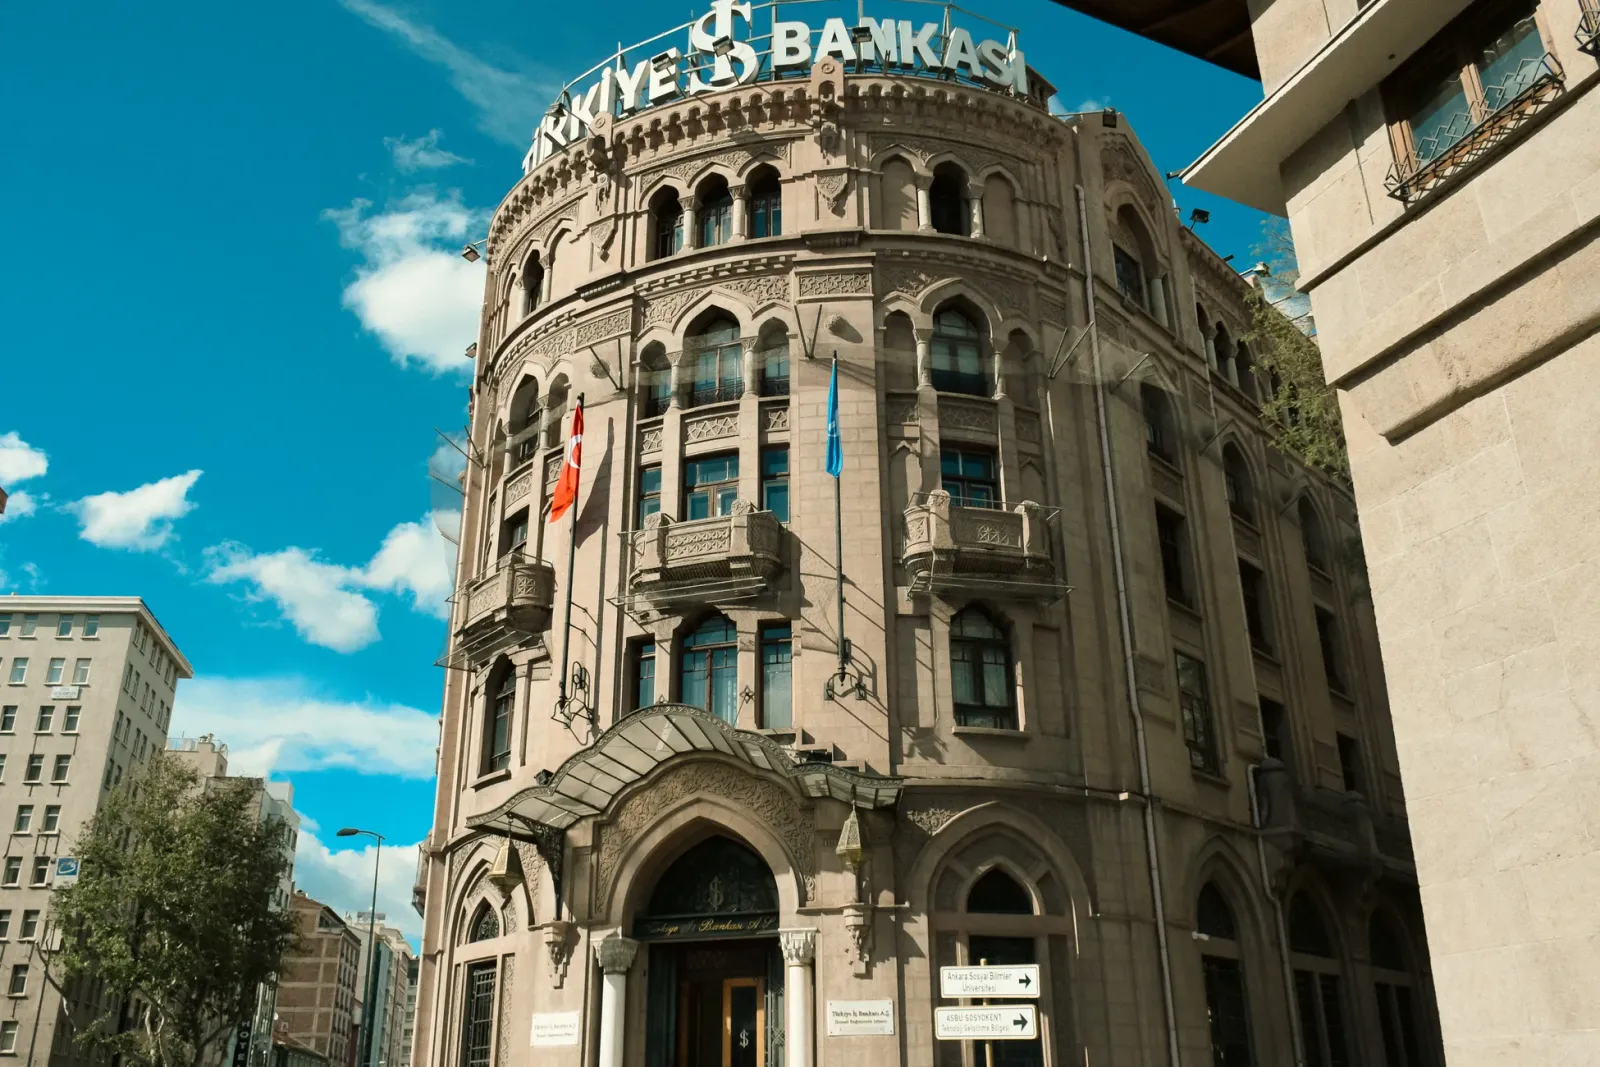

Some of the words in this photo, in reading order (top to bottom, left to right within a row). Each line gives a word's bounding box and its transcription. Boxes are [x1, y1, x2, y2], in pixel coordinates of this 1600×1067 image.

[774, 16, 1028, 97] BANKASI
[947, 972, 968, 981] Ankara
[969, 971, 988, 983] Sosyal
[989, 970, 1013, 980] Bilimler
[965, 1013, 1002, 1022] SOSYOKENT
[236, 1020, 251, 1067] HOTE
